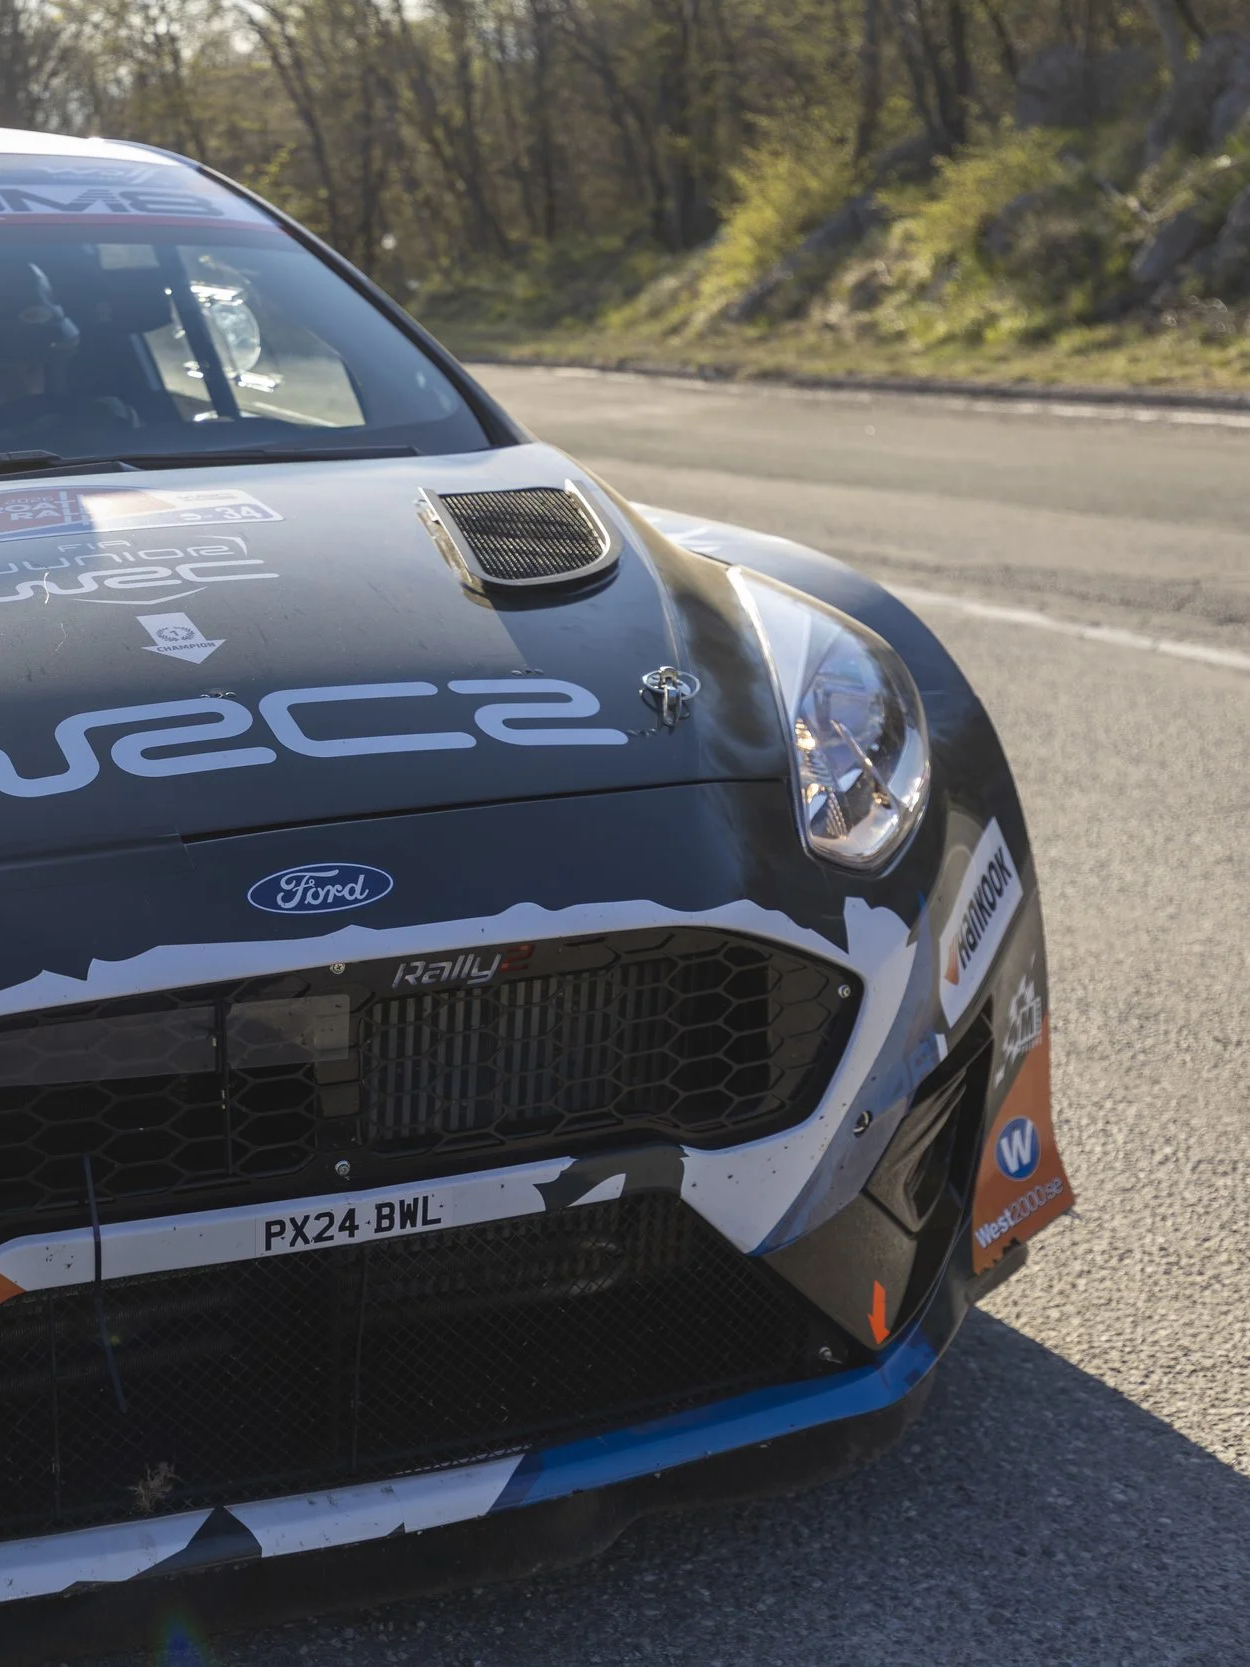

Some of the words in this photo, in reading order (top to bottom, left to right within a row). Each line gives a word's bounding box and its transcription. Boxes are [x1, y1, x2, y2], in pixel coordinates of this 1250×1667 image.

[214, 505, 263, 521] 34
[58, 539, 133, 553] FIA
[156, 641, 217, 653] CHAMPION
[276, 867, 371, 912] Ford
[392, 943, 535, 988] Rally2
[1001, 1119, 1034, 1174] W
[264, 1208, 360, 1251] PX24
[374, 1195, 442, 1233] BWL
